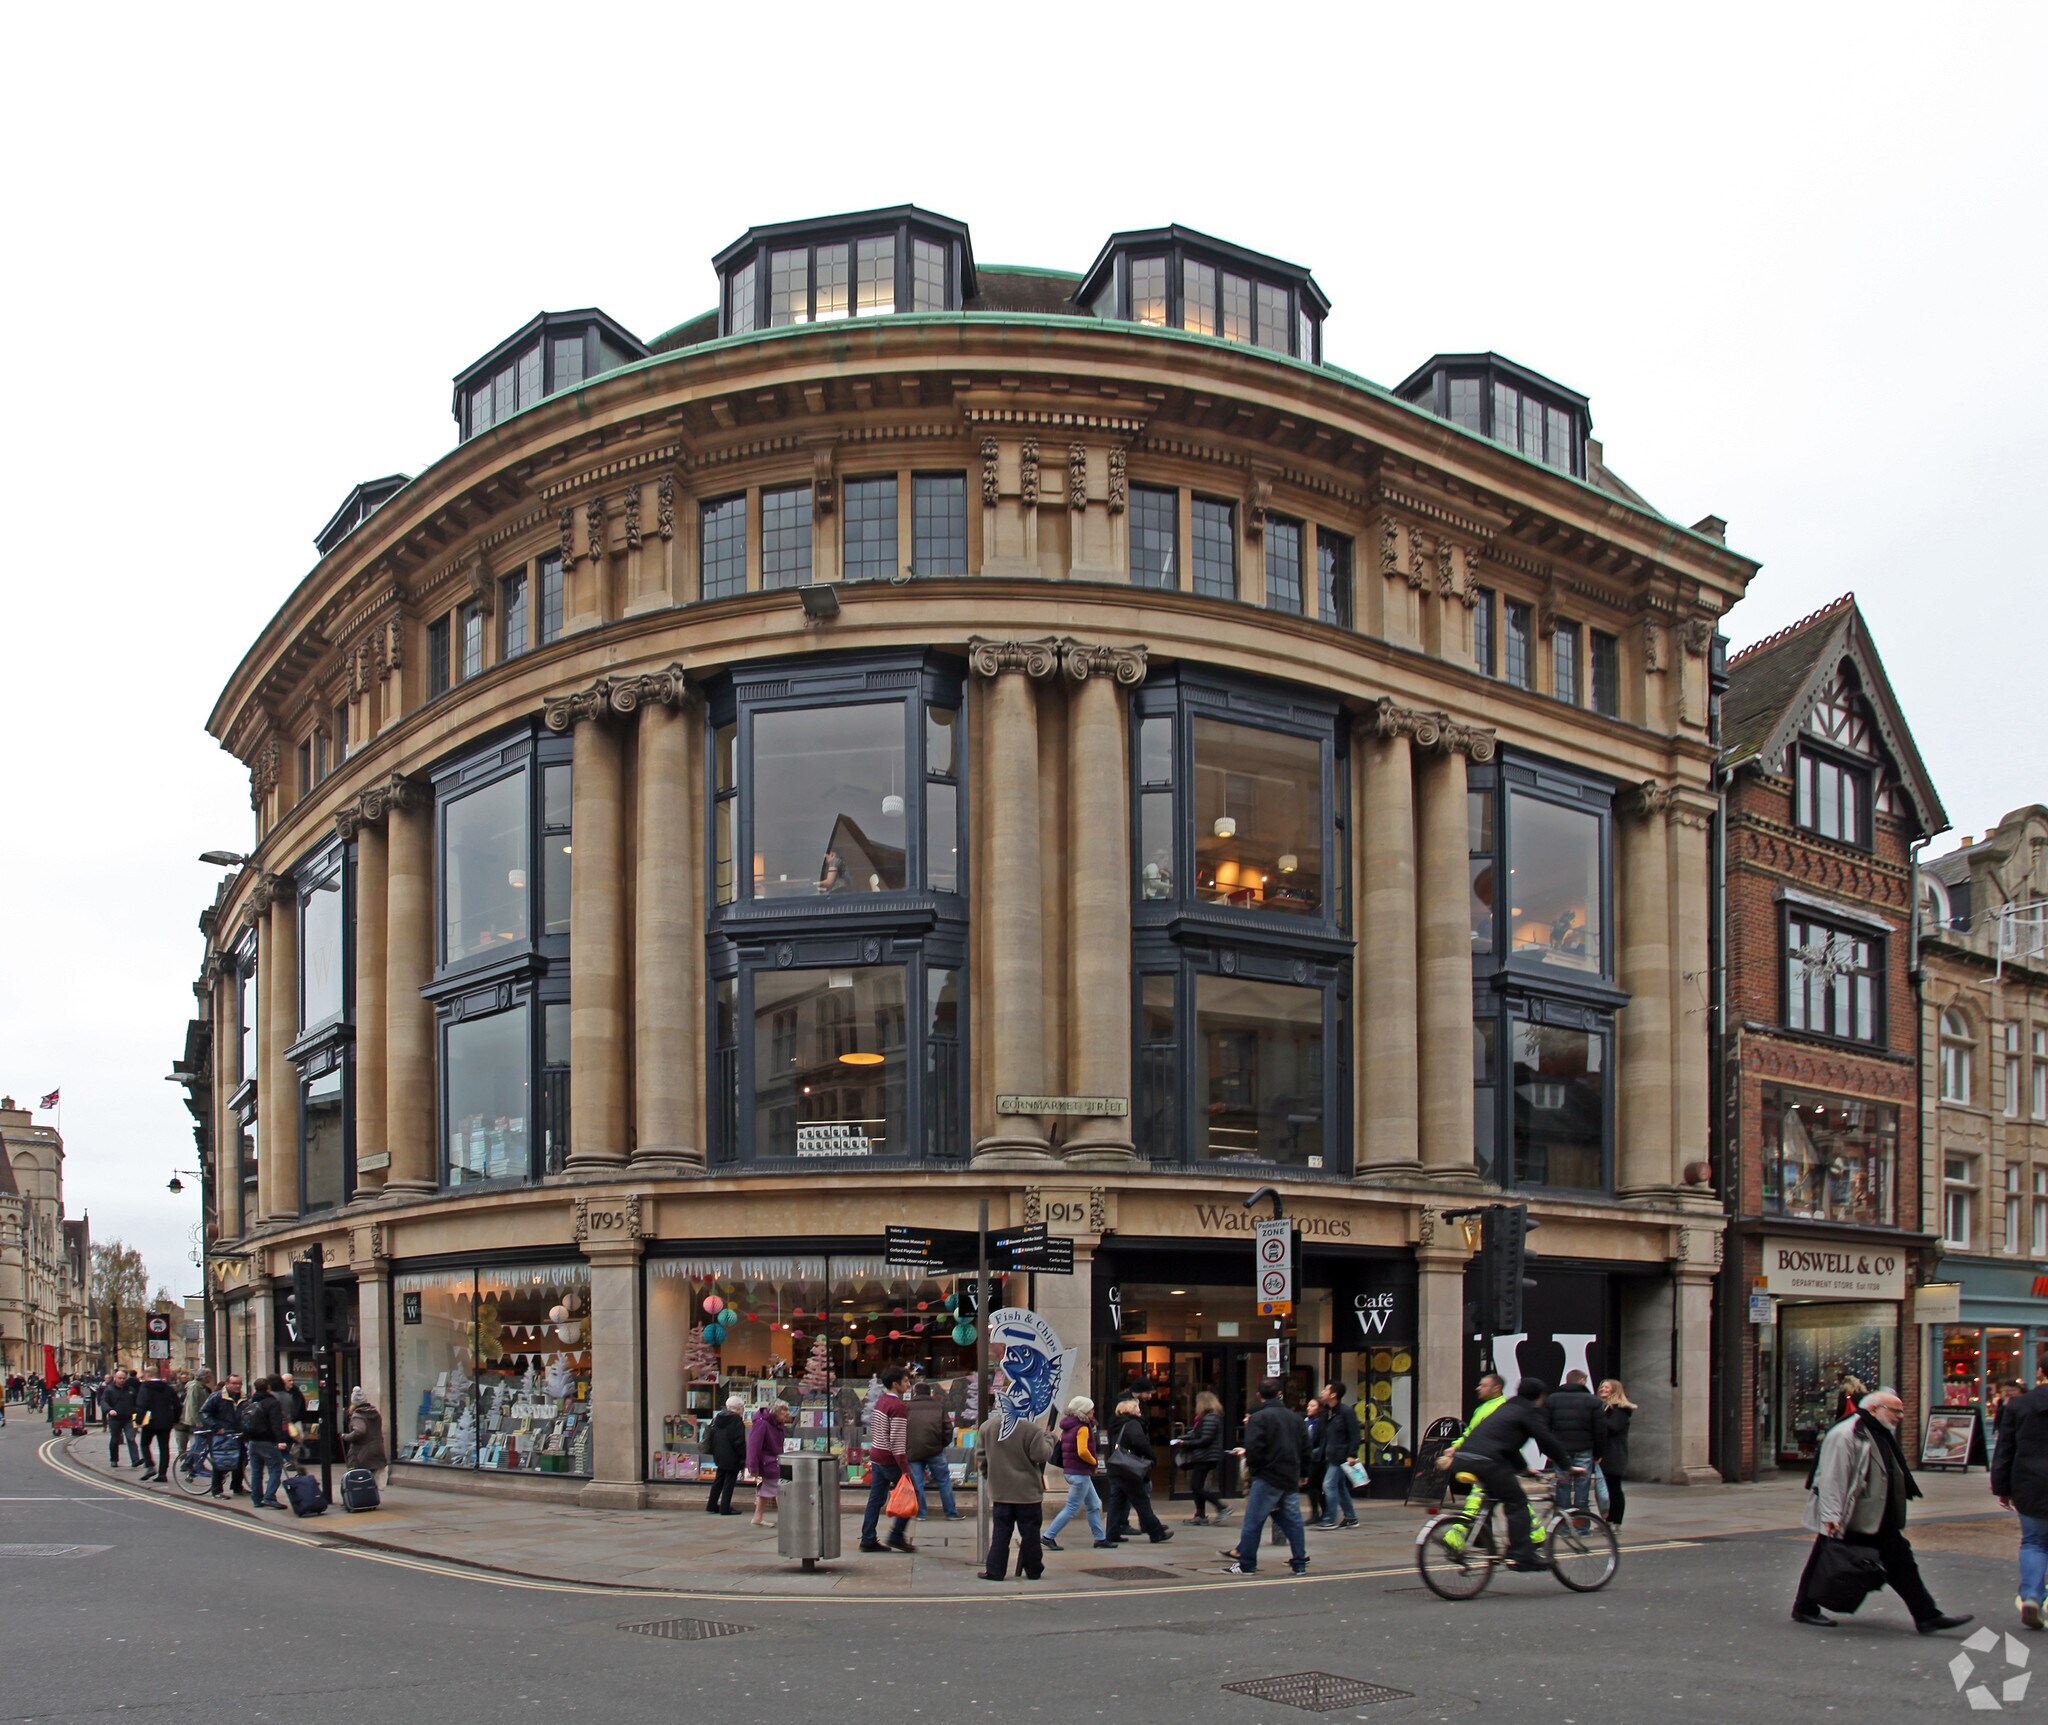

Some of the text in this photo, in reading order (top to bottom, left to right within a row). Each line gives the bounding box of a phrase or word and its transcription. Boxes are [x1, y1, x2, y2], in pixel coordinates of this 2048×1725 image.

[1001, 1099, 1123, 1112] CORNMARKET STREET
[1045, 1203, 1084, 1222] 1915
[591, 1212, 624, 1230] 1795
[1258, 1221, 1290, 1229] Pedestrian
[1262, 1228, 1285, 1237] ZONE
[1778, 1250, 1855, 1274] BOSWELL
[1857, 1255, 1871, 1275] &
[1792, 1278, 1832, 1288] DEPARTMENT
[1834, 1281, 1854, 1289] STORE
[1354, 1292, 1394, 1309] Café
[407, 1305, 418, 1319] W
[1354, 1309, 1394, 1335] W
[994, 1311, 1058, 1353] Fish & Chips
[1440, 1427, 1452, 1436] W
